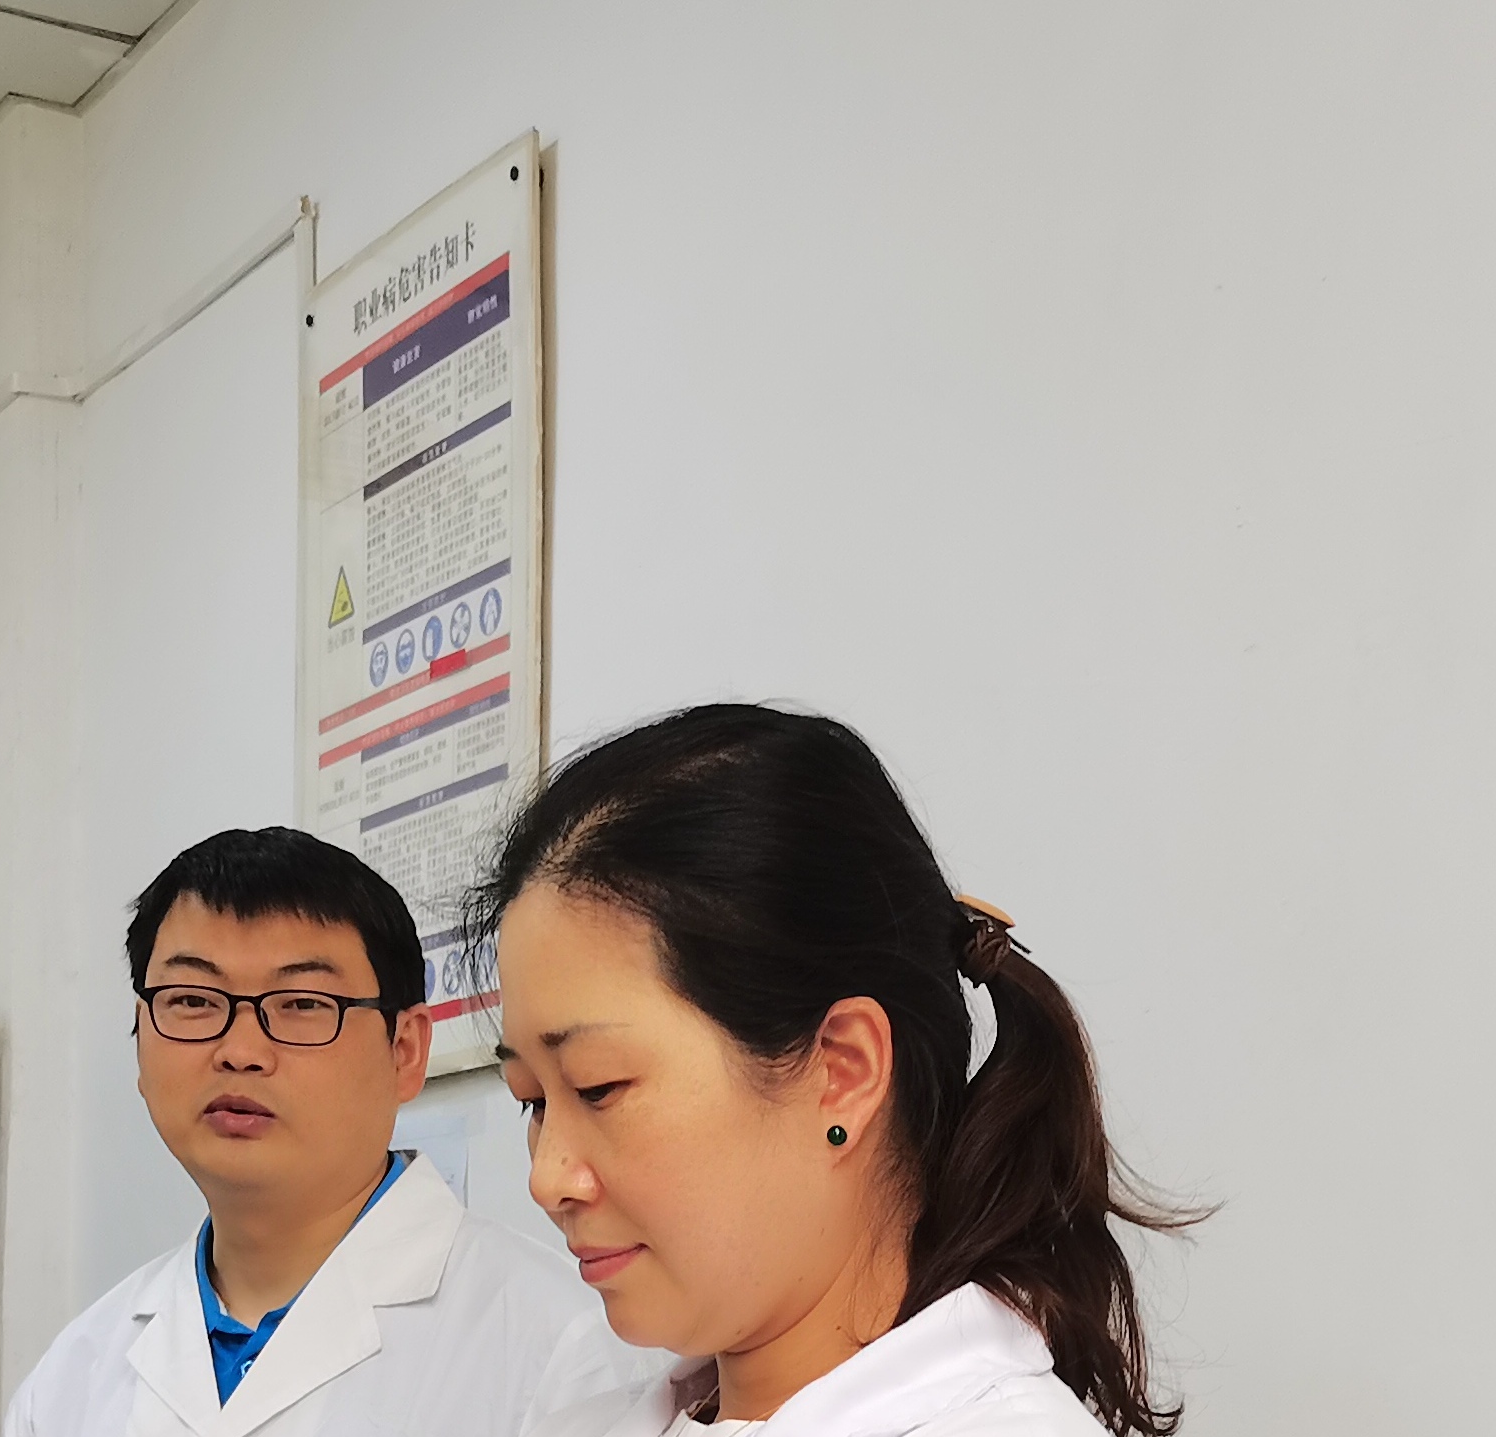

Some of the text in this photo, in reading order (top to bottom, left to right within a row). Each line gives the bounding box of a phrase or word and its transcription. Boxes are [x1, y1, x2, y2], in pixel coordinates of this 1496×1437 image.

[353, 219, 477, 336] 职业病危害告知卡
